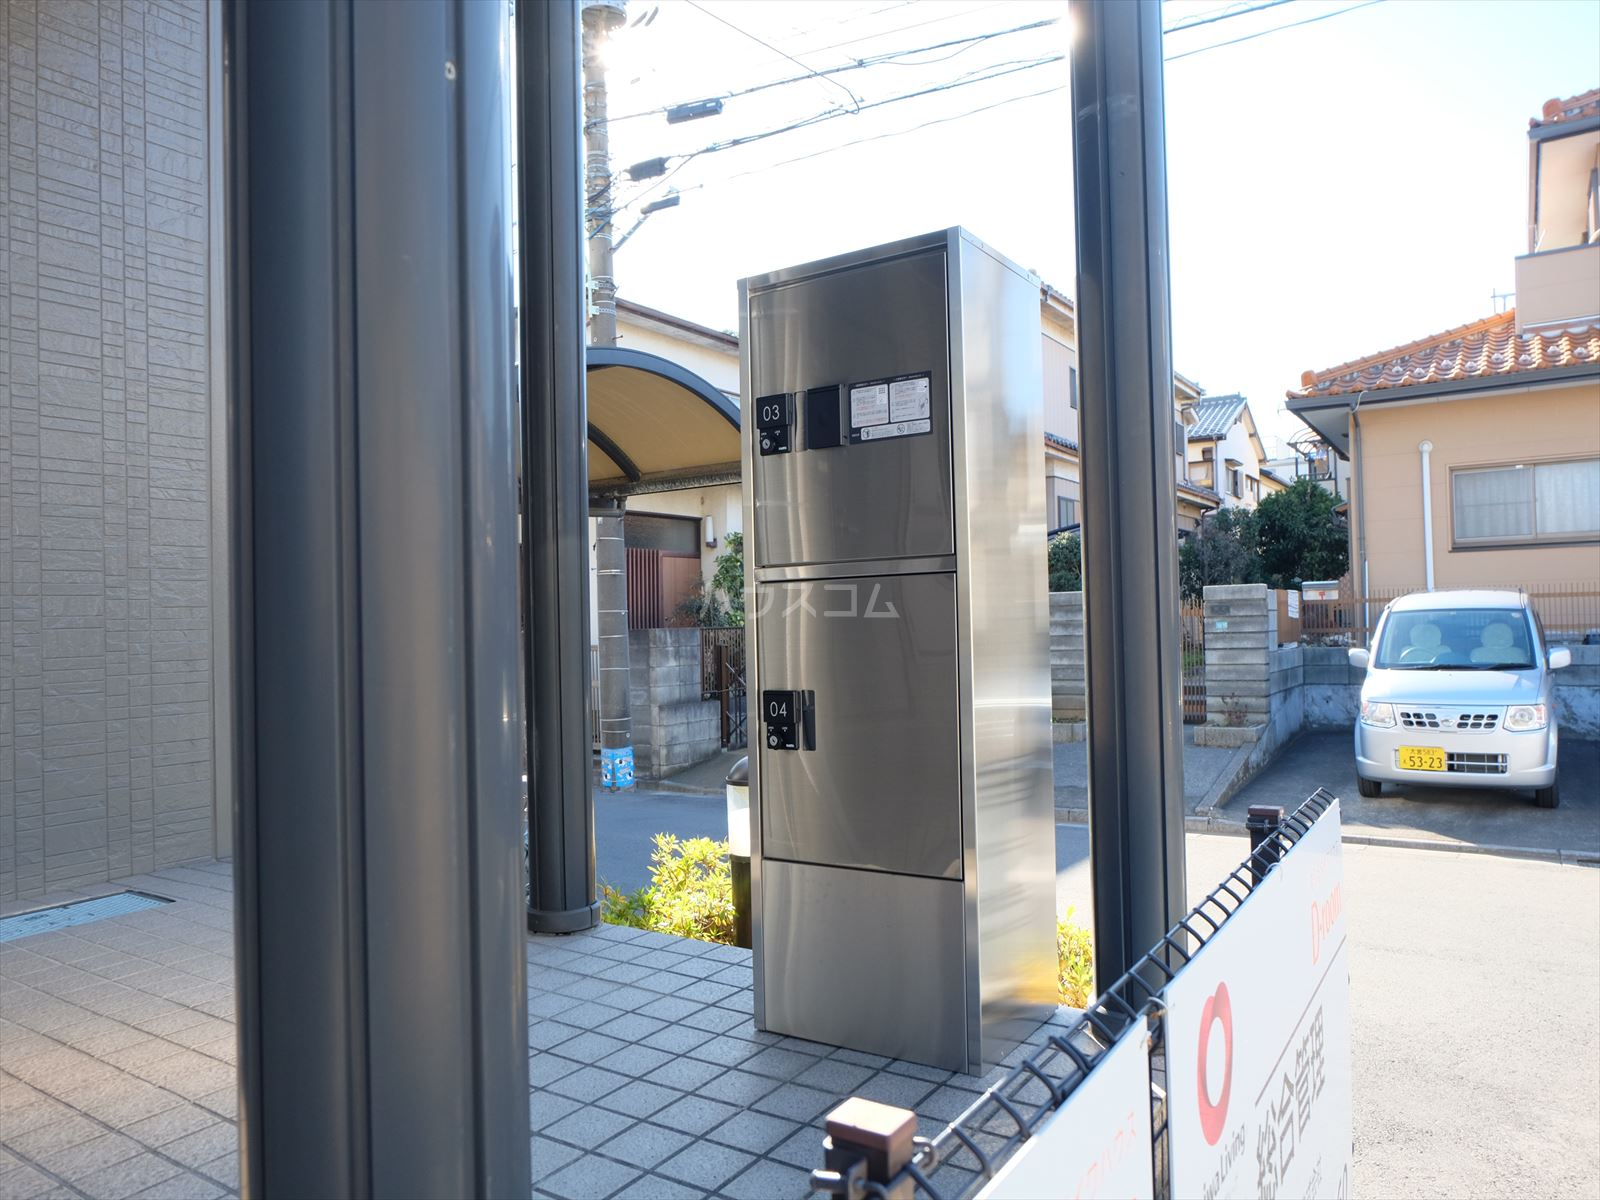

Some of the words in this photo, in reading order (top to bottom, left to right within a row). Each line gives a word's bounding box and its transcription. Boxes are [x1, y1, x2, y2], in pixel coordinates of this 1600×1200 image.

[763, 404, 780, 422] 03
[770, 701, 788, 718] 04
[1409, 756, 1442, 768] 53-23
[1220, 1120, 1246, 1184] Living
